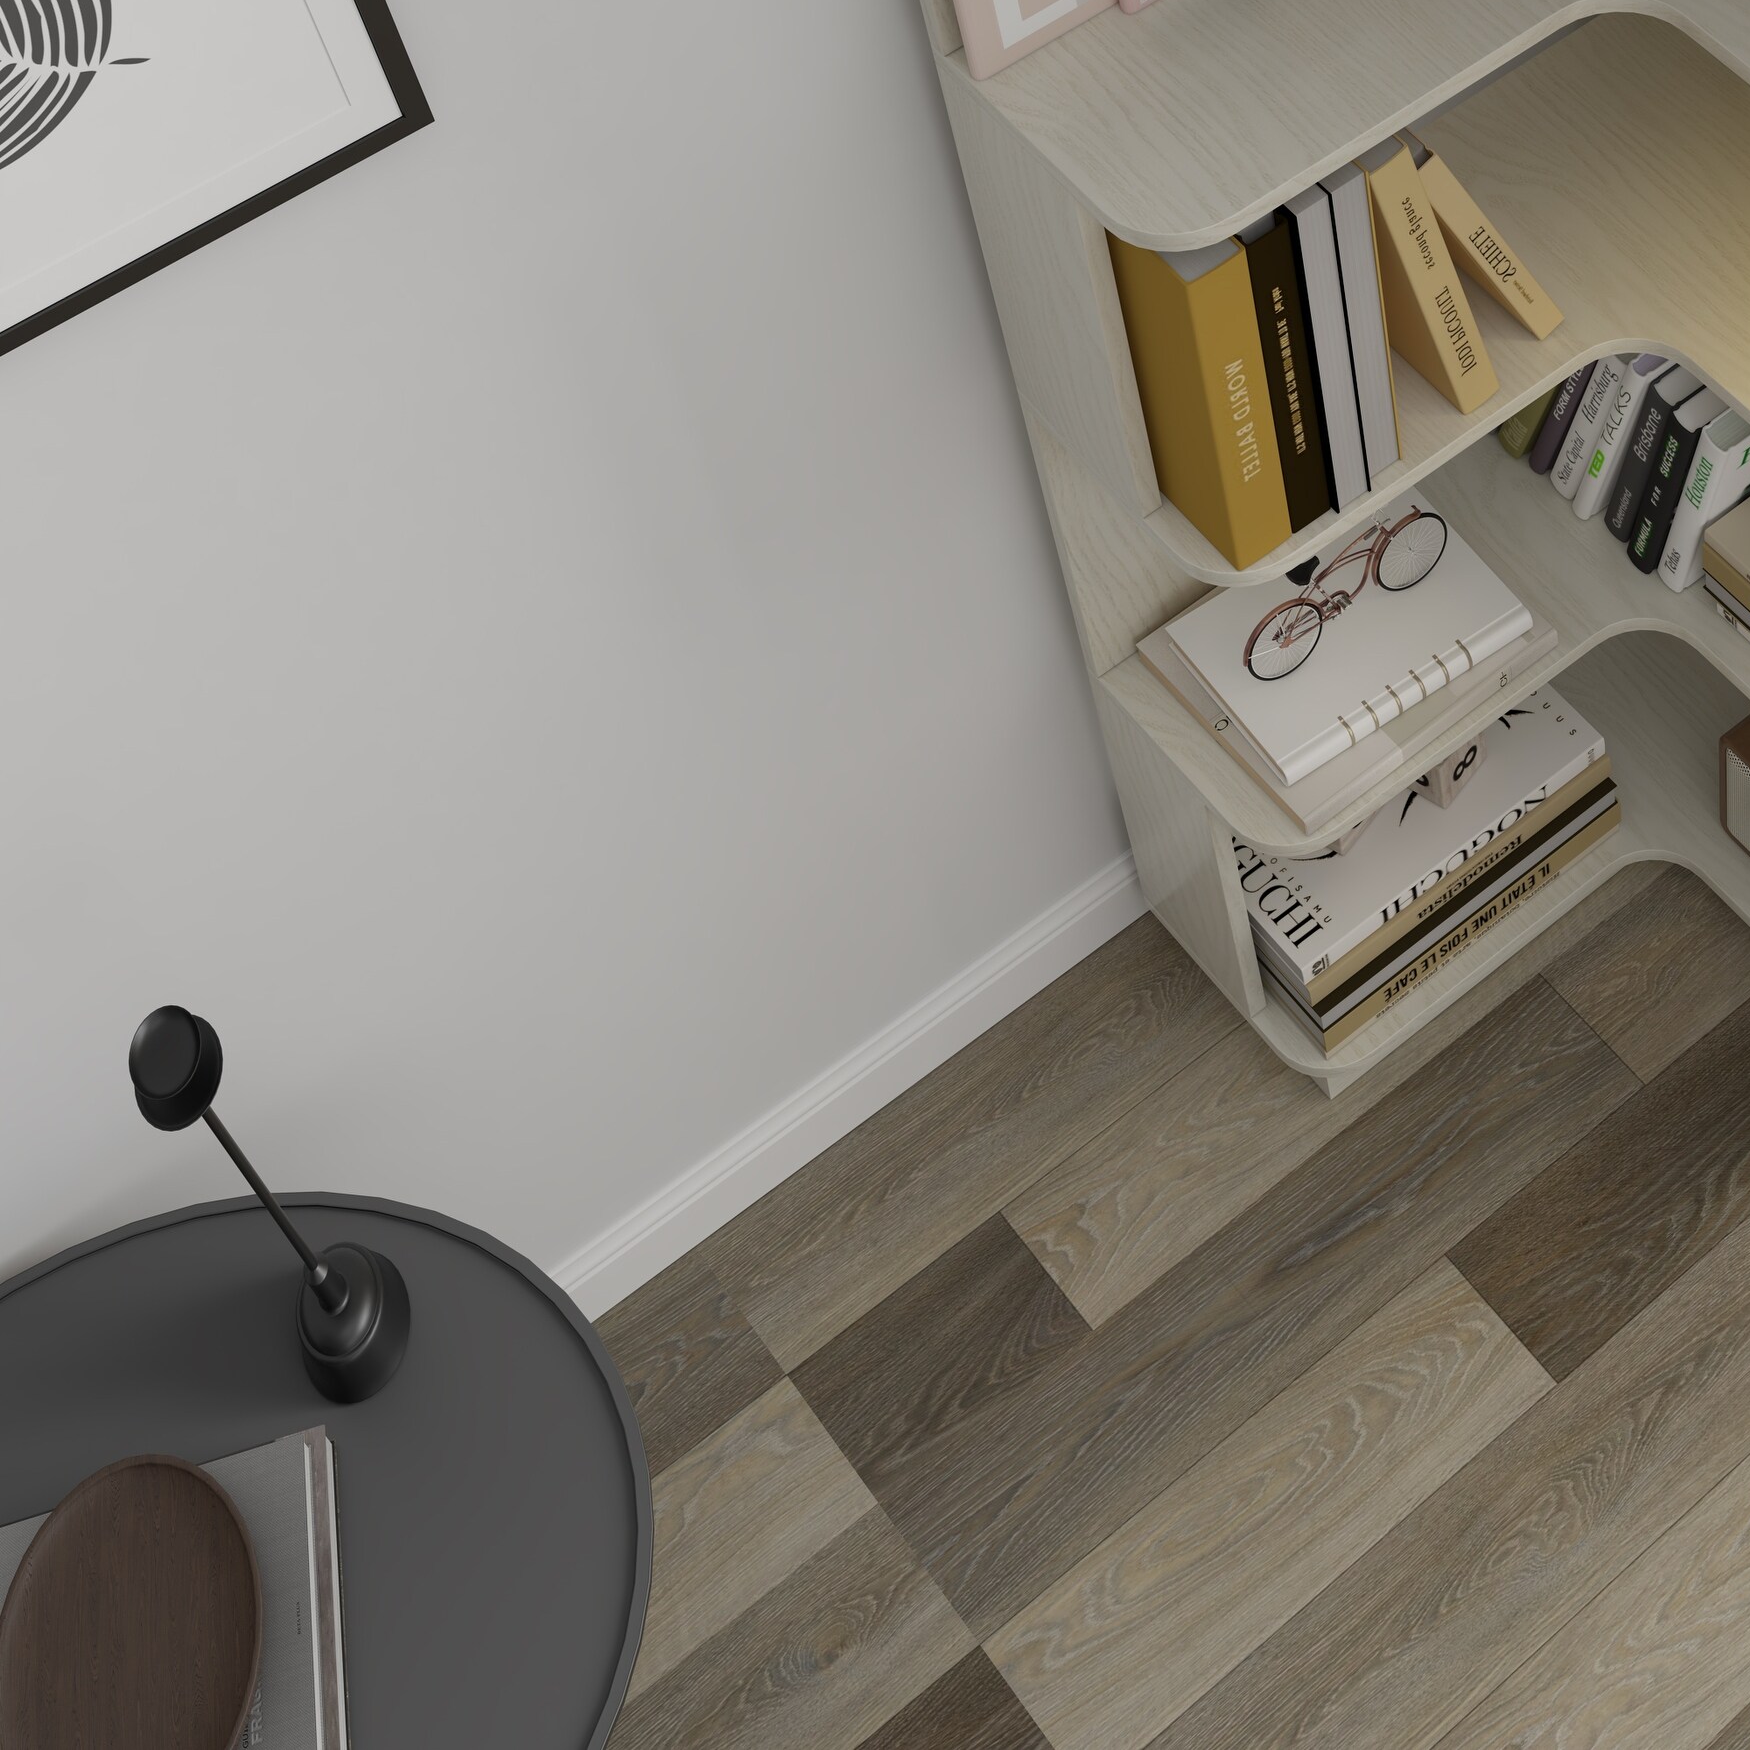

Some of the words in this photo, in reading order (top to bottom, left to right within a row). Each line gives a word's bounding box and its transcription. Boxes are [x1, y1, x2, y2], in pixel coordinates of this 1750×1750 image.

[1553, 390, 1570, 421] FORM
[1557, 462, 1571, 485] State
[1565, 430, 1585, 465] Capital
[1582, 364, 1619, 424] Harrisburg
[1588, 449, 1605, 479] TED
[1600, 385, 1632, 446] TALKS
[1612, 487, 1632, 529] Queensland
[1633, 407, 1661, 463] Brisbane
[1685, 456, 1714, 511] Houston
[1634, 517, 1653, 557] FORMULA
[1650, 485, 1662, 507] FOR
[1659, 435, 1679, 478] SUCCESS
[1417, 834, 1522, 919] Remodelista
[1538, 863, 1551, 878] IL
[1501, 875, 1537, 911] ÉTAIT
[1471, 905, 1497, 934] UNE
[1440, 928, 1469, 958] FOIS
[1421, 952, 1437, 973] LE
[1383, 968, 1417, 1003] CAFÉ
